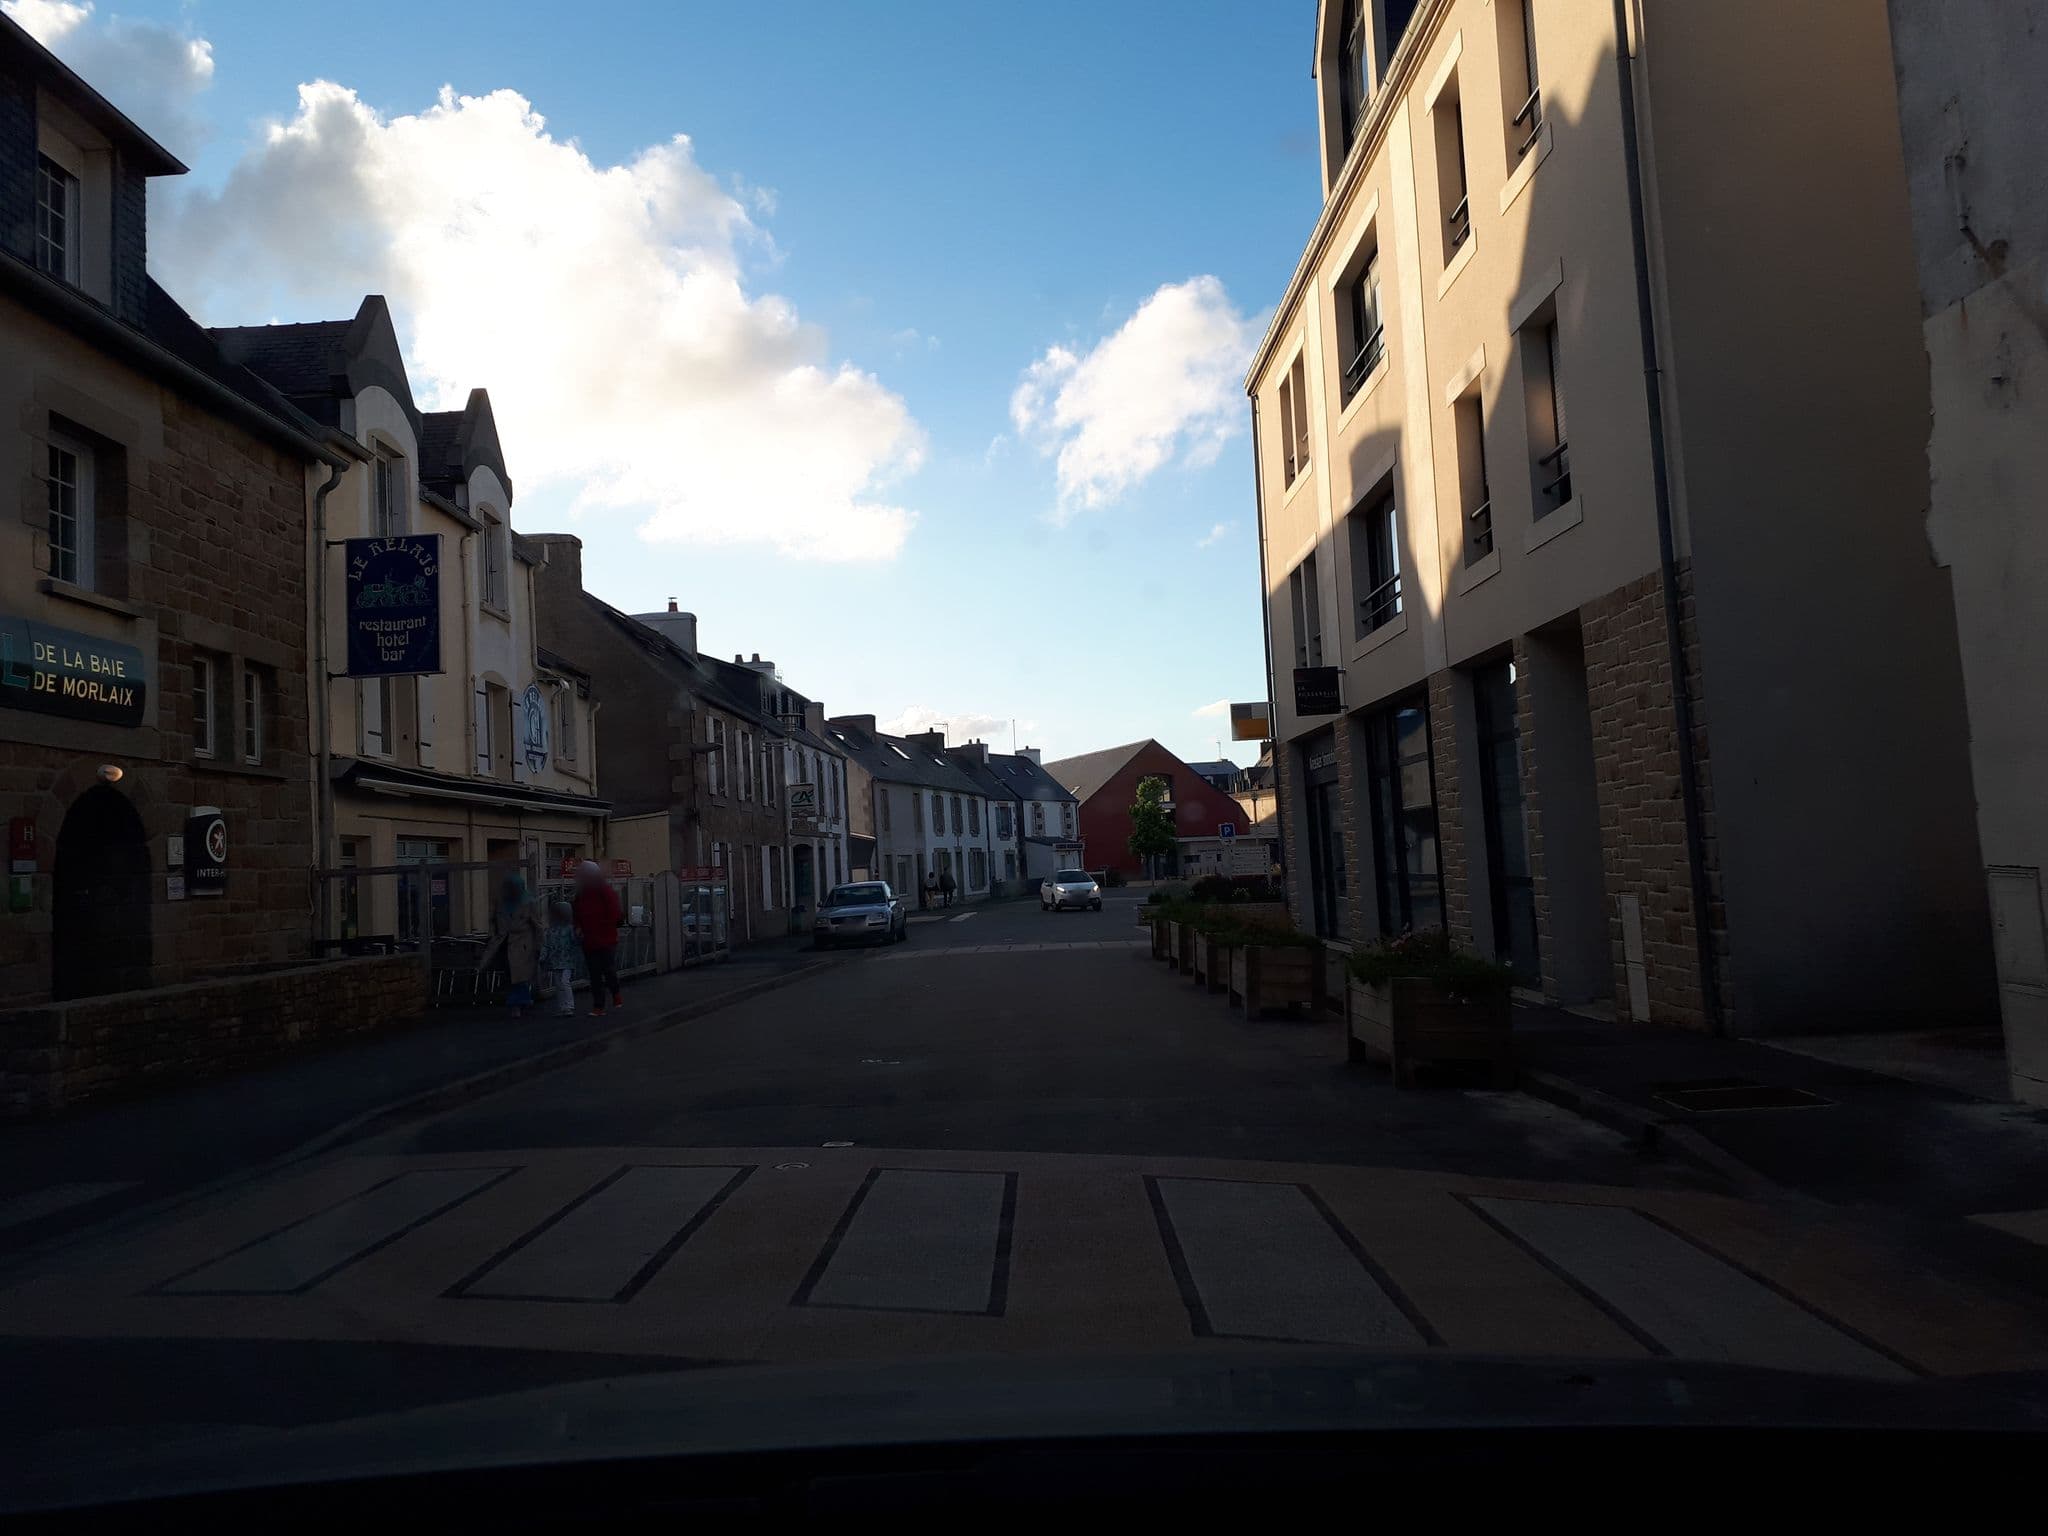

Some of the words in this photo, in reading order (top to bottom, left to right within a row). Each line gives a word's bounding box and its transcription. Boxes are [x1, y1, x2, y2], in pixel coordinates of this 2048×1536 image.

[348, 556, 368, 581] LE
[368, 538, 438, 576] RELAIS
[360, 616, 427, 632] restaurant
[376, 631, 409, 647] hotel
[33, 641, 57, 664] DE
[62, 648, 84, 670] LA
[90, 654, 126, 678] BAIE
[381, 647, 405, 661] bar
[33, 671, 57, 693] DE
[62, 676, 134, 706] MORLAIX
